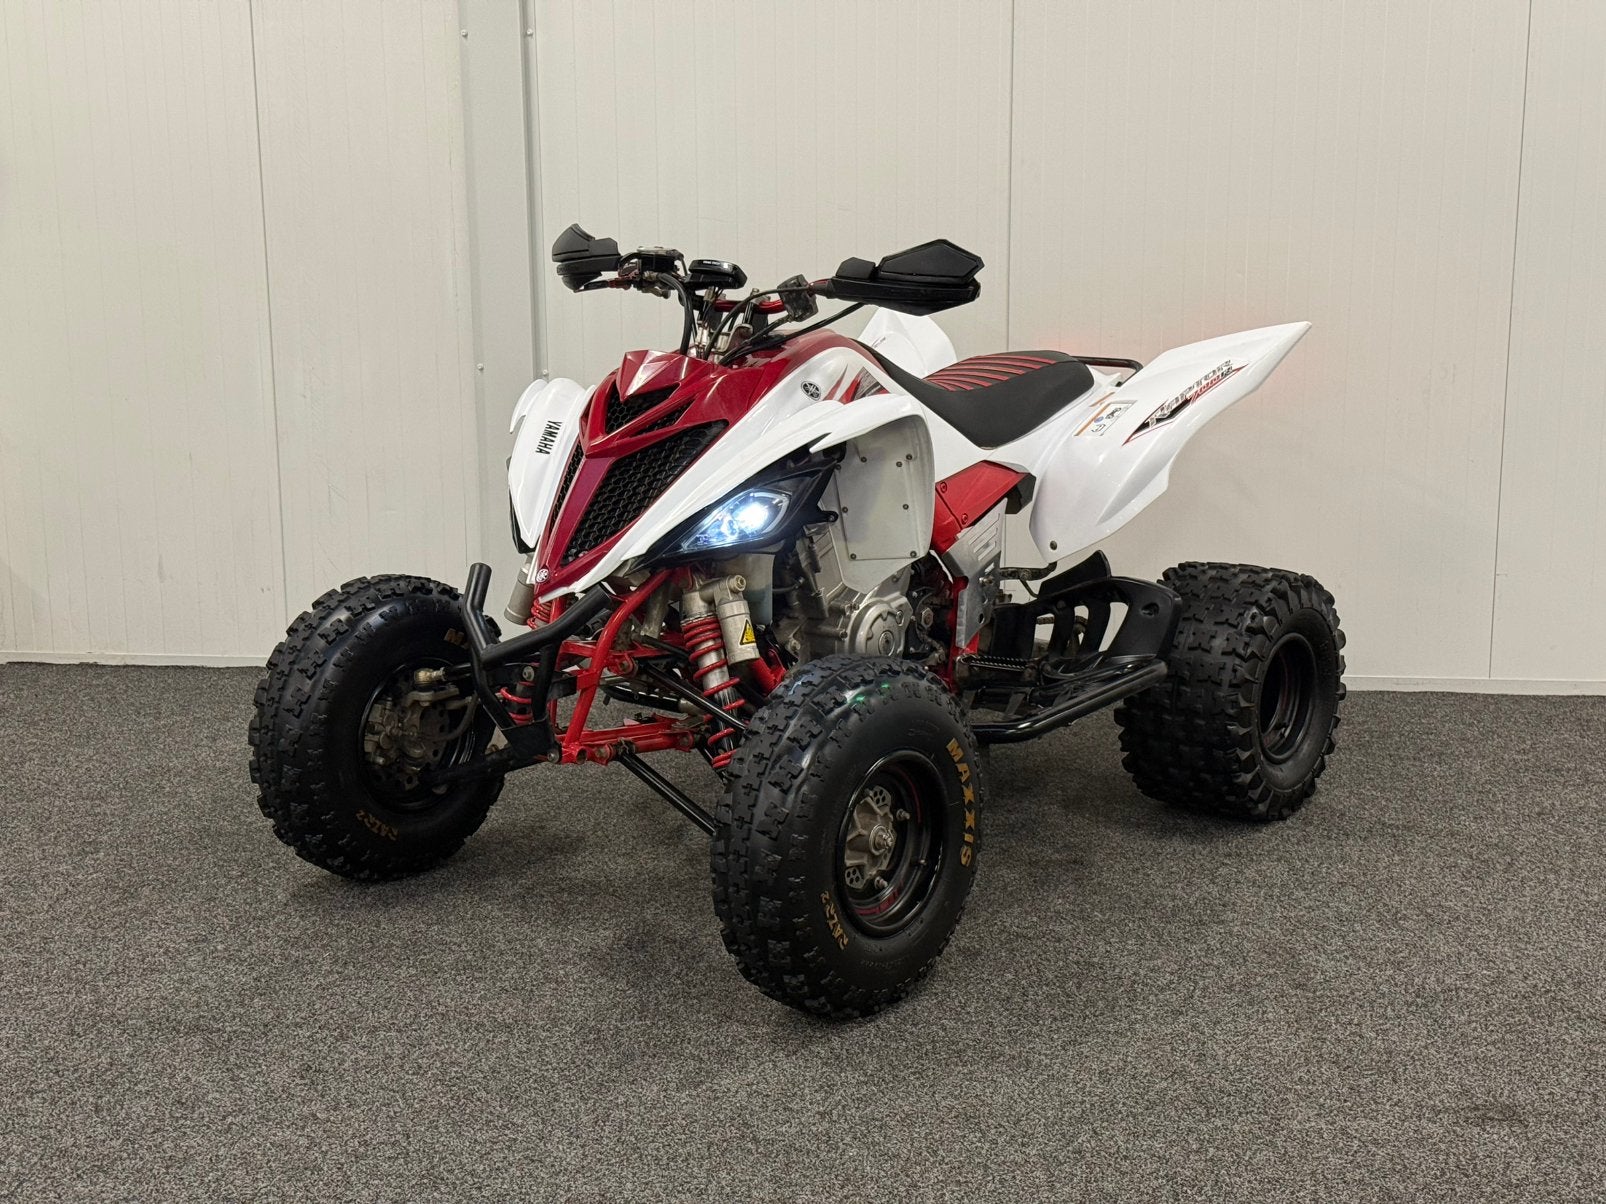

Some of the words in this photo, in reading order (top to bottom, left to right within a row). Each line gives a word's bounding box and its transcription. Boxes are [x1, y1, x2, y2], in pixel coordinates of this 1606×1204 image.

[1145, 359, 1232, 428] RAPTOR
[535, 420, 562, 454] YAMAHA
[945, 737, 976, 867] MAXXIS
